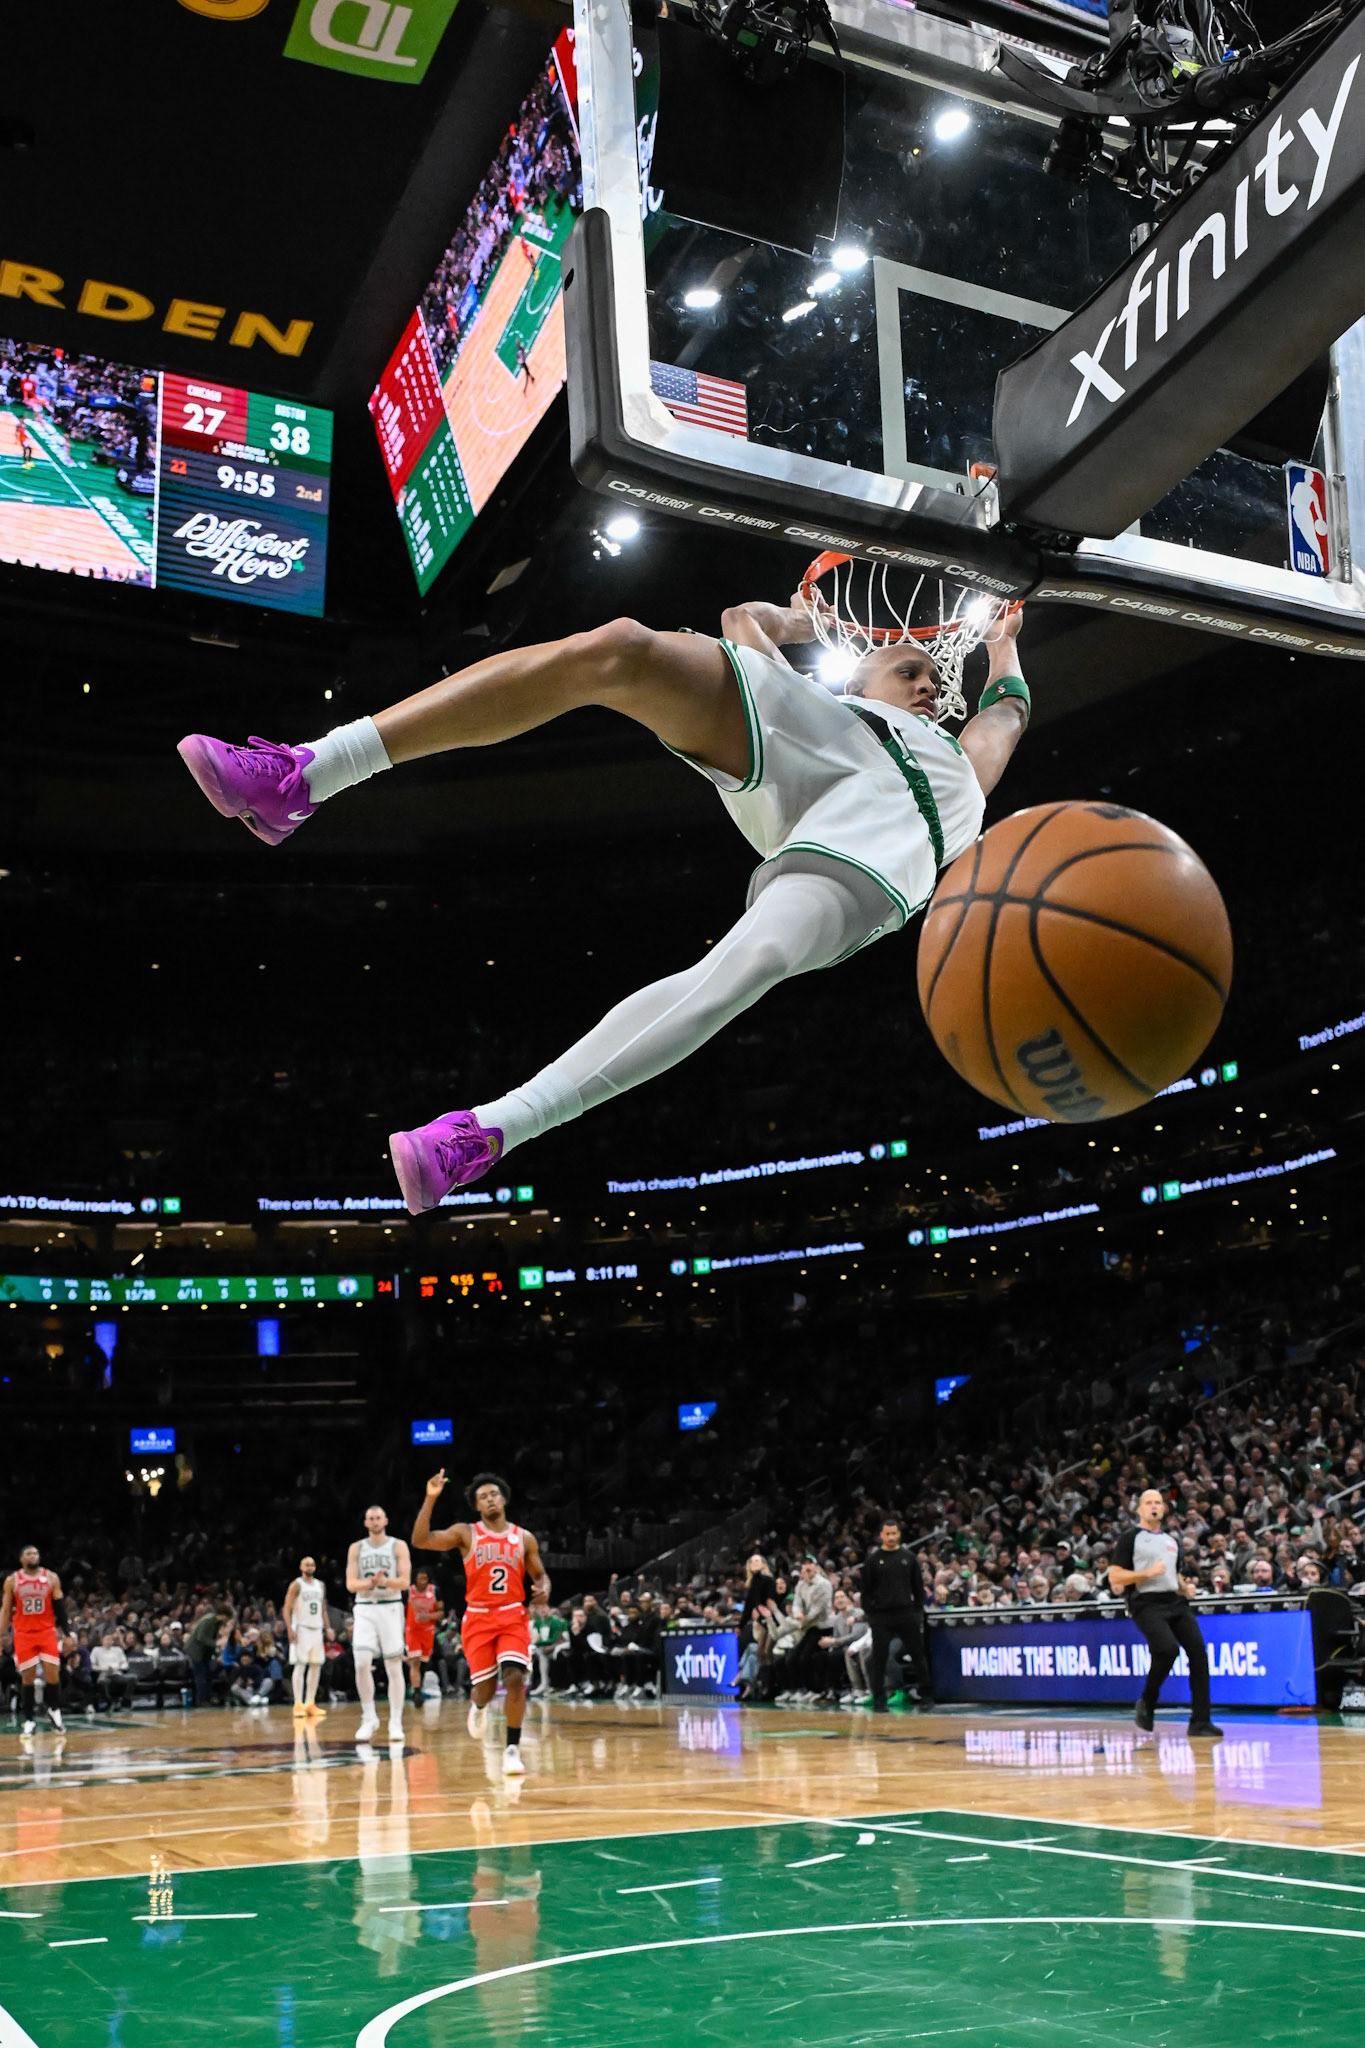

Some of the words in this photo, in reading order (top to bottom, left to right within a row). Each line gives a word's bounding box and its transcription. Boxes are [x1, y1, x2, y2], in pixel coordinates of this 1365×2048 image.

[1065, 52, 1362, 427] xfinity
[0, 260, 313, 357] RDEN
[182, 402, 226, 435] 27
[269, 422, 311, 455] 38
[170, 459, 187, 475] 22
[217, 465, 276, 498] 9:55
[296, 485, 322, 502] 2nd
[608, 480, 646, 498] C4
[645, 492, 694, 511] ENERGY
[698, 507, 736, 521] C4
[733, 514, 780, 530] ENERGY
[172, 512, 310, 560] Different
[784, 526, 820, 540] C4
[818, 534, 863, 550] ENERGY
[211, 548, 292, 584] Here
[866, 546, 902, 559] C4
[898, 553, 943, 568] ENERGY
[1296, 550, 1318, 572] NBA
[944, 564, 978, 580] C4
[975, 575, 1019, 594] ENERGY
[1036, 589, 1069, 598] C4
[1109, 597, 1142, 609] C4
[1180, 612, 1213, 624] C4
[1248, 627, 1280, 640] C4
[760, 1162, 776, 1176] TD
[776, 1157, 819, 1173] Garden
[17, 1195, 36, 1209] TD
[37, 1196, 85, 1211] Garden
[522, 1270, 542, 1285] TD
[545, 1268, 576, 1283] Bank
[586, 1265, 613, 1281] 8:11
[615, 1264, 638, 1279] PM
[377, 1280, 392, 1292] 24
[490, 1567, 507, 1593] 2
[24, 1597, 45, 1614] 28
[309, 1602, 318, 1615] 9
[674, 1644, 727, 1684] xfinity
[961, 1646, 1023, 1677] IMAGINE
[1023, 1645, 1054, 1676] THE
[1055, 1645, 1097, 1676] NBA.
[1099, 1644, 1131, 1676] ALL
[1131, 1643, 1151, 1676] IN
[1207, 1641, 1266, 1676] LACE.
